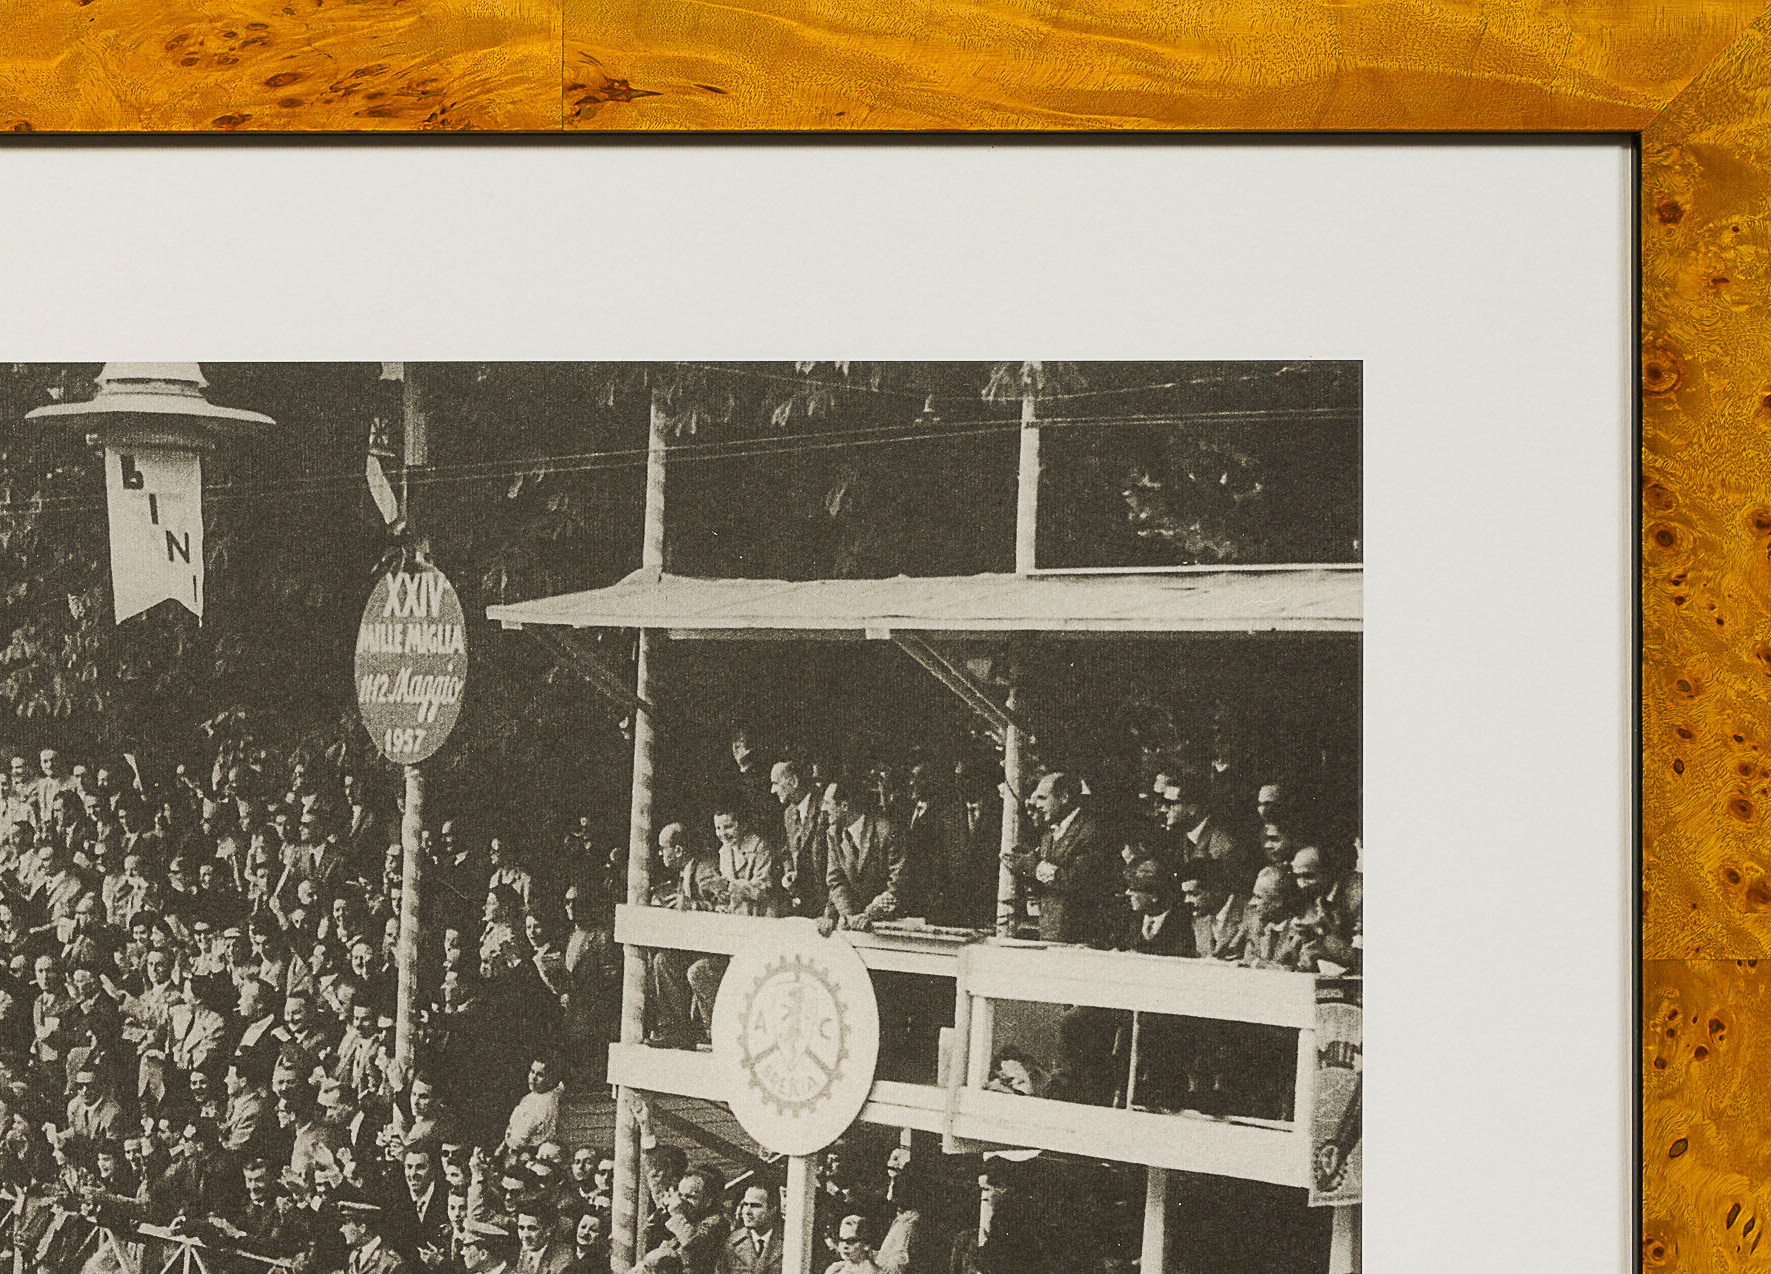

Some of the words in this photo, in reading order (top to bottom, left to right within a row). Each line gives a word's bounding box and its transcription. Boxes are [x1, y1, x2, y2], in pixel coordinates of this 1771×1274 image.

[382, 572, 444, 618] XXIV
[359, 623, 404, 654] MILLE
[405, 623, 465, 654] MIGLIA
[384, 728, 427, 753] 1957
